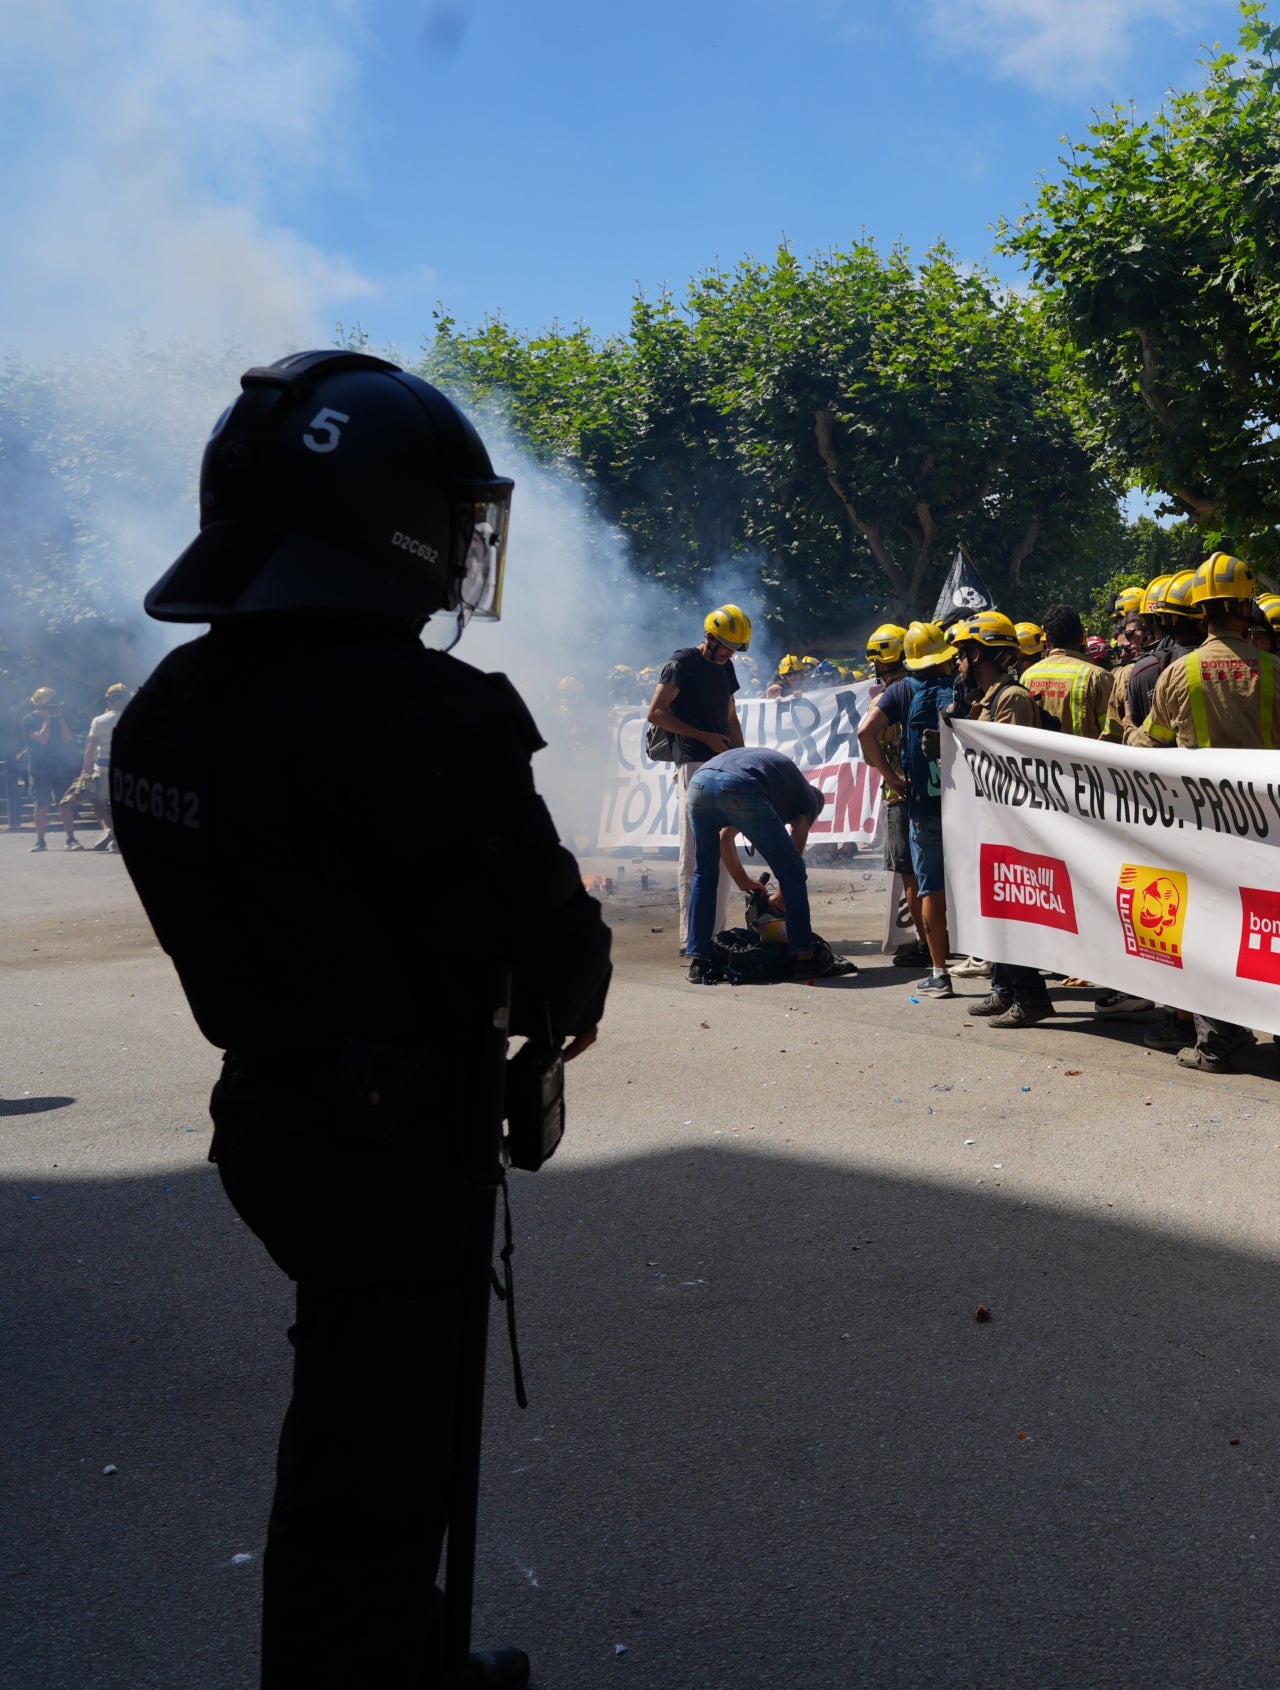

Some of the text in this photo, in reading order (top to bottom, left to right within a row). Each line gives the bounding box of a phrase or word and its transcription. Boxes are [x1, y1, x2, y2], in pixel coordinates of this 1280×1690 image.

[303, 407, 350, 453] 5
[392, 531, 439, 564] D2C632
[1201, 658, 1258, 669] bombers
[1030, 679, 1066, 689] bombers
[114, 767, 200, 829] D2C632
[964, 748, 1070, 814] BOMBERS
[1070, 762, 1106, 820] EN
[1107, 767, 1185, 829] RISC:
[1181, 776, 1270, 840] PROU
[993, 883, 1066, 914] SINDICAL
